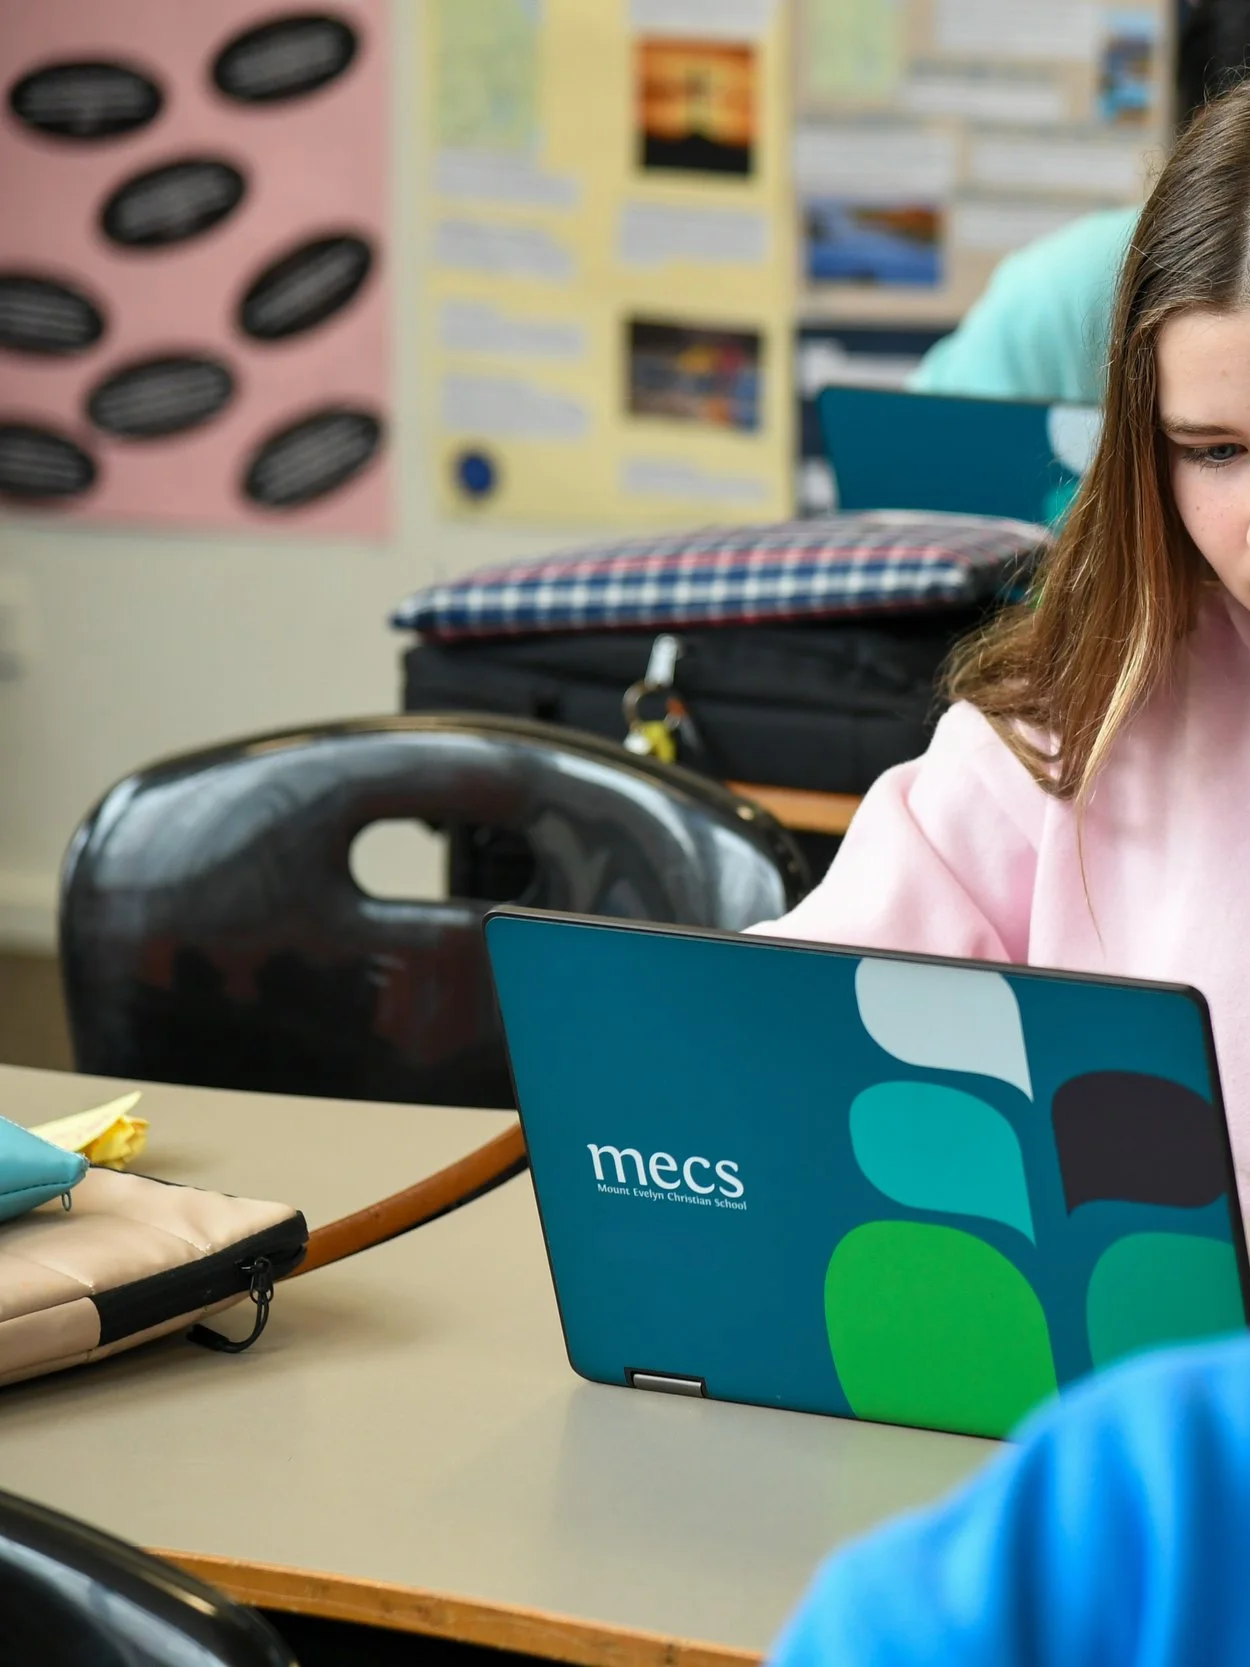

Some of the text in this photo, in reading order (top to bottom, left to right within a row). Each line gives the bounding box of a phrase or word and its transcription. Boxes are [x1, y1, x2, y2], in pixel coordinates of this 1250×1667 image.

[587, 1144, 745, 1198] mecs
[597, 1183, 747, 1211] Mount Evelyn Christian School
